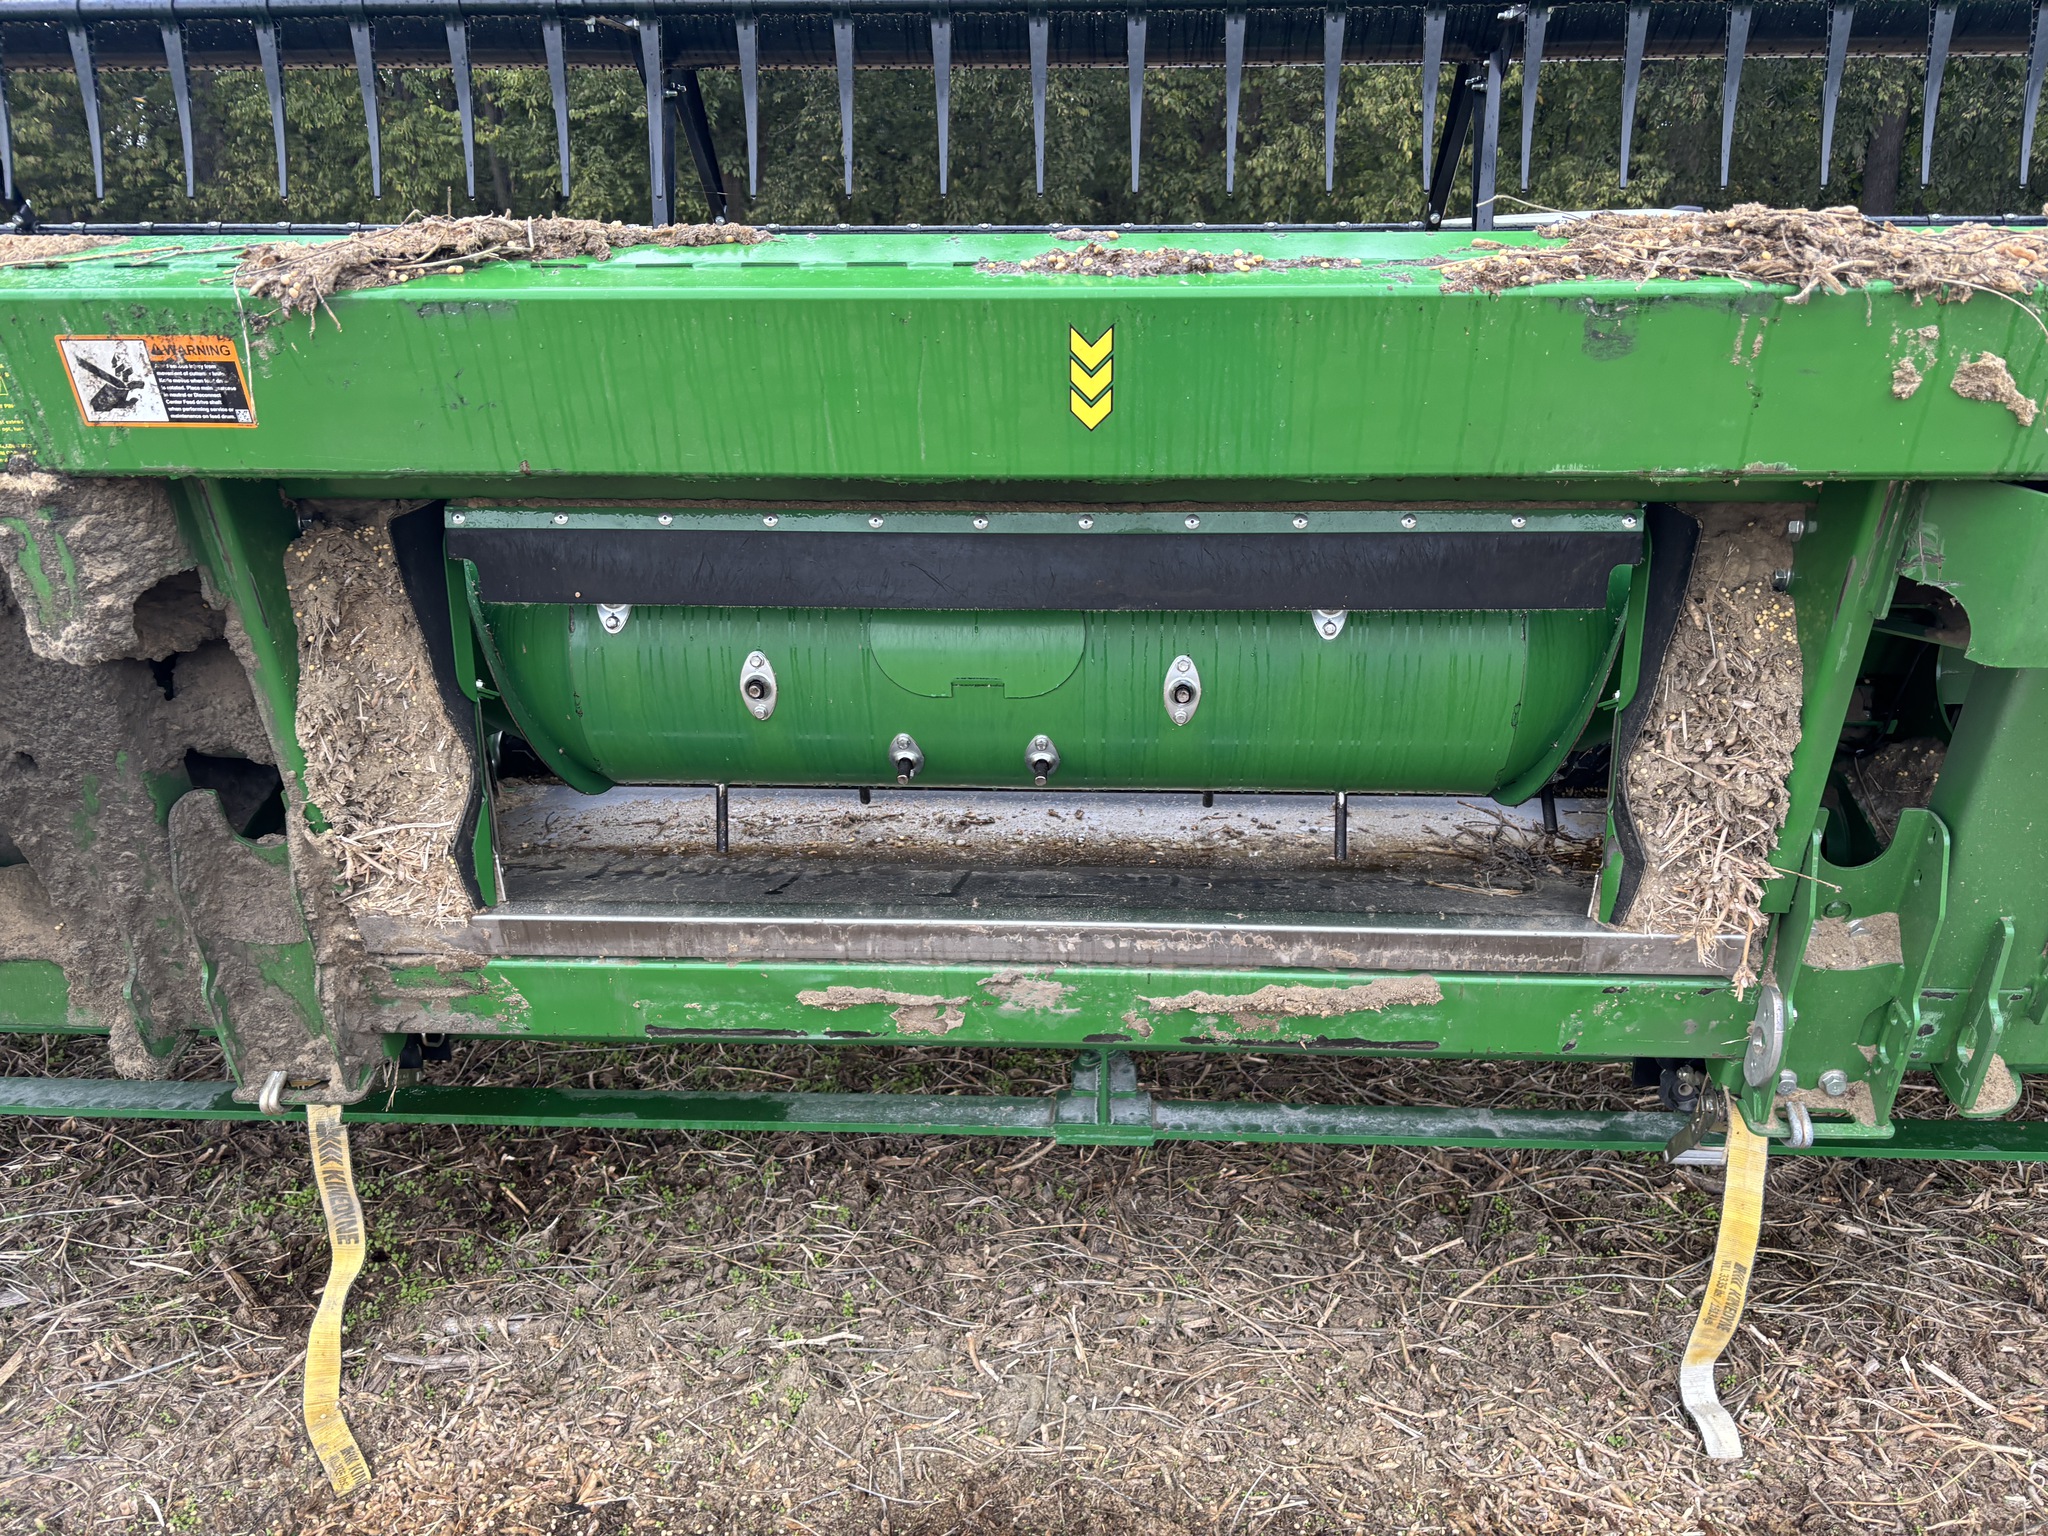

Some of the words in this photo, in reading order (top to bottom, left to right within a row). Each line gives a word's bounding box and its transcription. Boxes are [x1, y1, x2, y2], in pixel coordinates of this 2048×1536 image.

[163, 344, 231, 356] WARNING
[321, 1169, 360, 1245] KINEDYNE
[1716, 1288, 1742, 1333] KINEDYNE
